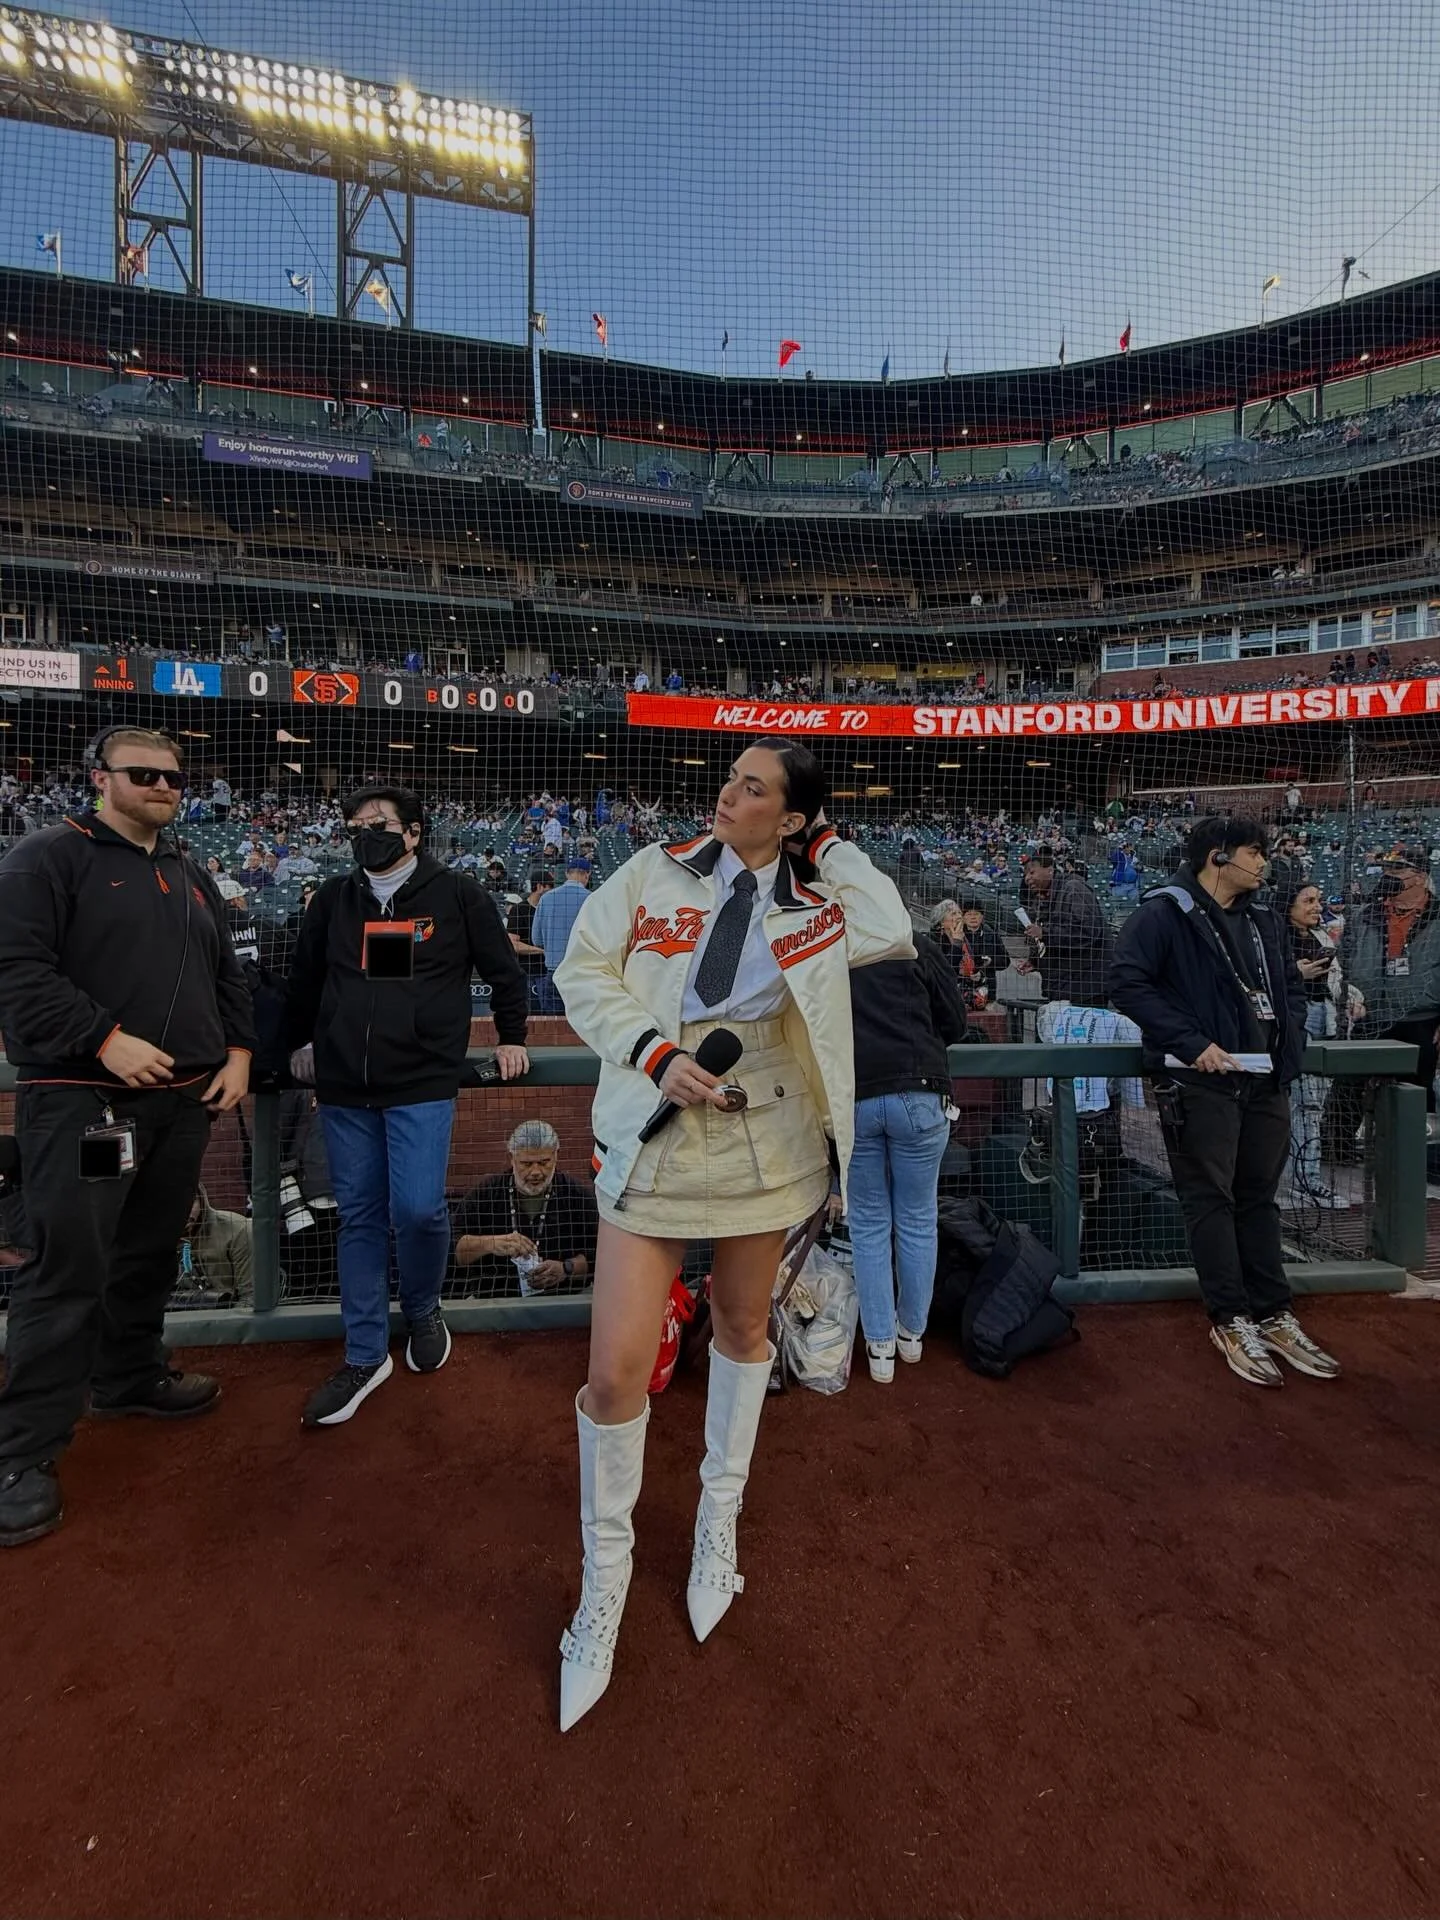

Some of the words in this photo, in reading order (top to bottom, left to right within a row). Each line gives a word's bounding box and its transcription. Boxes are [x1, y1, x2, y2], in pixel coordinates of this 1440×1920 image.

[218, 438, 248, 453] Enjoy
[249, 442, 335, 463] homerun-worthy
[336, 452, 359, 464] WiFi
[587, 489, 604, 497] HOME
[614, 492, 625, 500] THE
[626, 494, 638, 502] SAN
[639, 496, 670, 506] FRANCISCO
[671, 500, 692, 508] GIANTS
[112, 566, 136, 575] HOME
[139, 568, 148, 576] OF
[152, 568, 168, 577] THE
[170, 571, 201, 580] GIANTS
[0, 657, 25, 668] IND
[29, 659, 46, 669] US
[49, 661, 61, 670] IN
[50, 672, 68, 681] 136
[117, 658, 127, 679] 1
[94, 679, 135, 690] INNING
[172, 662, 204, 695] LA
[249, 671, 268, 697] 0
[314, 673, 339, 704] SF
[384, 680, 403, 706] 0
[427, 690, 438, 703] B
[441, 684, 460, 710] 0
[467, 692, 477, 706] S
[479, 687, 497, 712] 0
[517, 690, 535, 715] 0
[713, 704, 830, 729] WELCOME
[839, 709, 869, 730] TO
[913, 703, 1122, 735] STANFORD
[1132, 682, 1412, 731] UNIVERSITY
[629, 904, 669, 949] San
